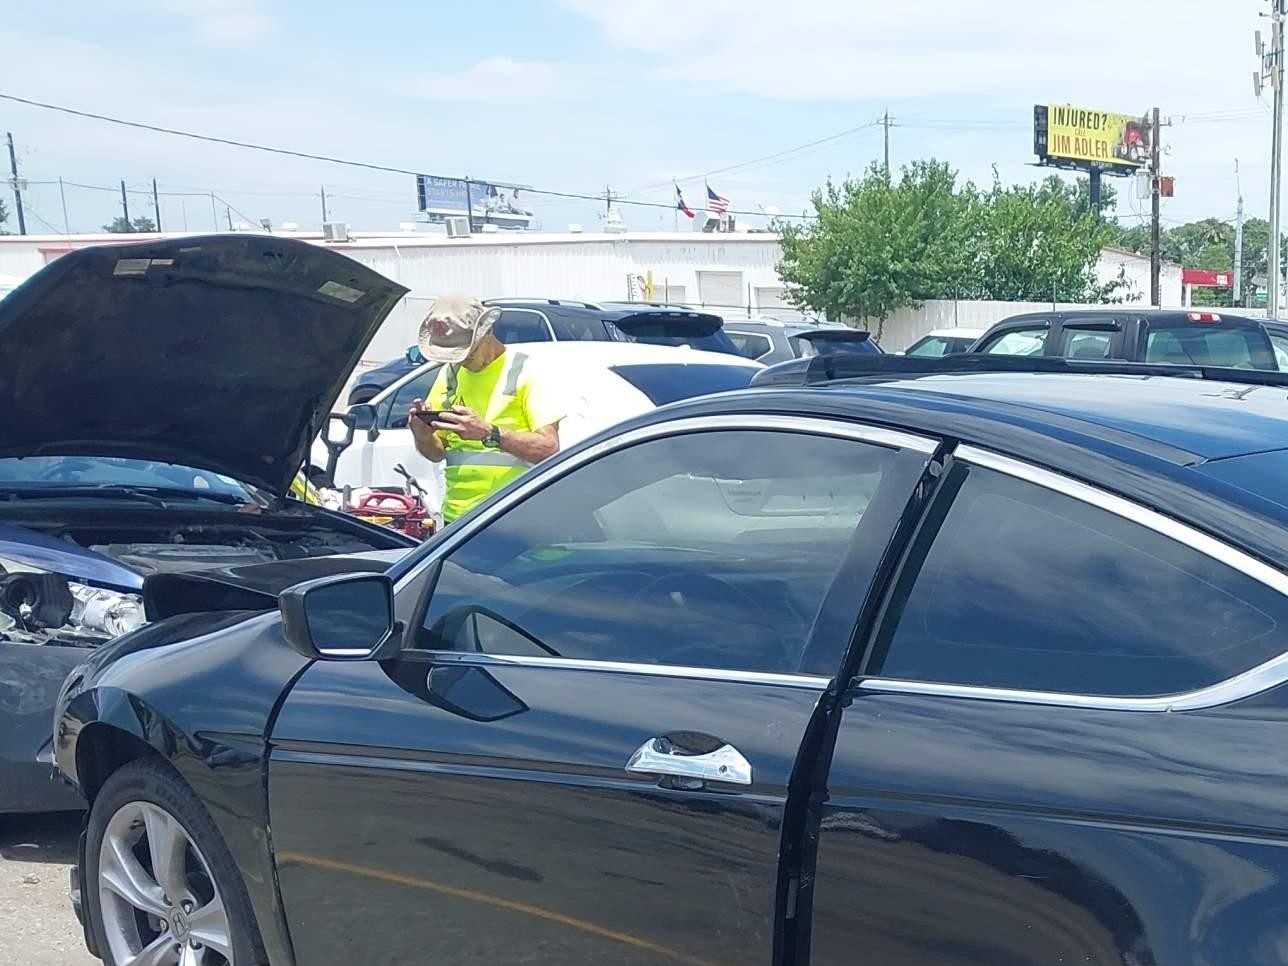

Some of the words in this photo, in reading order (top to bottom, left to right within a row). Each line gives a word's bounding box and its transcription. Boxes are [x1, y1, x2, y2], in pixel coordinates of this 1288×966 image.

[1053, 107, 1107, 131] INJURED?
[1052, 133, 1071, 153] JIM
[1074, 136, 1108, 158] ADLER
